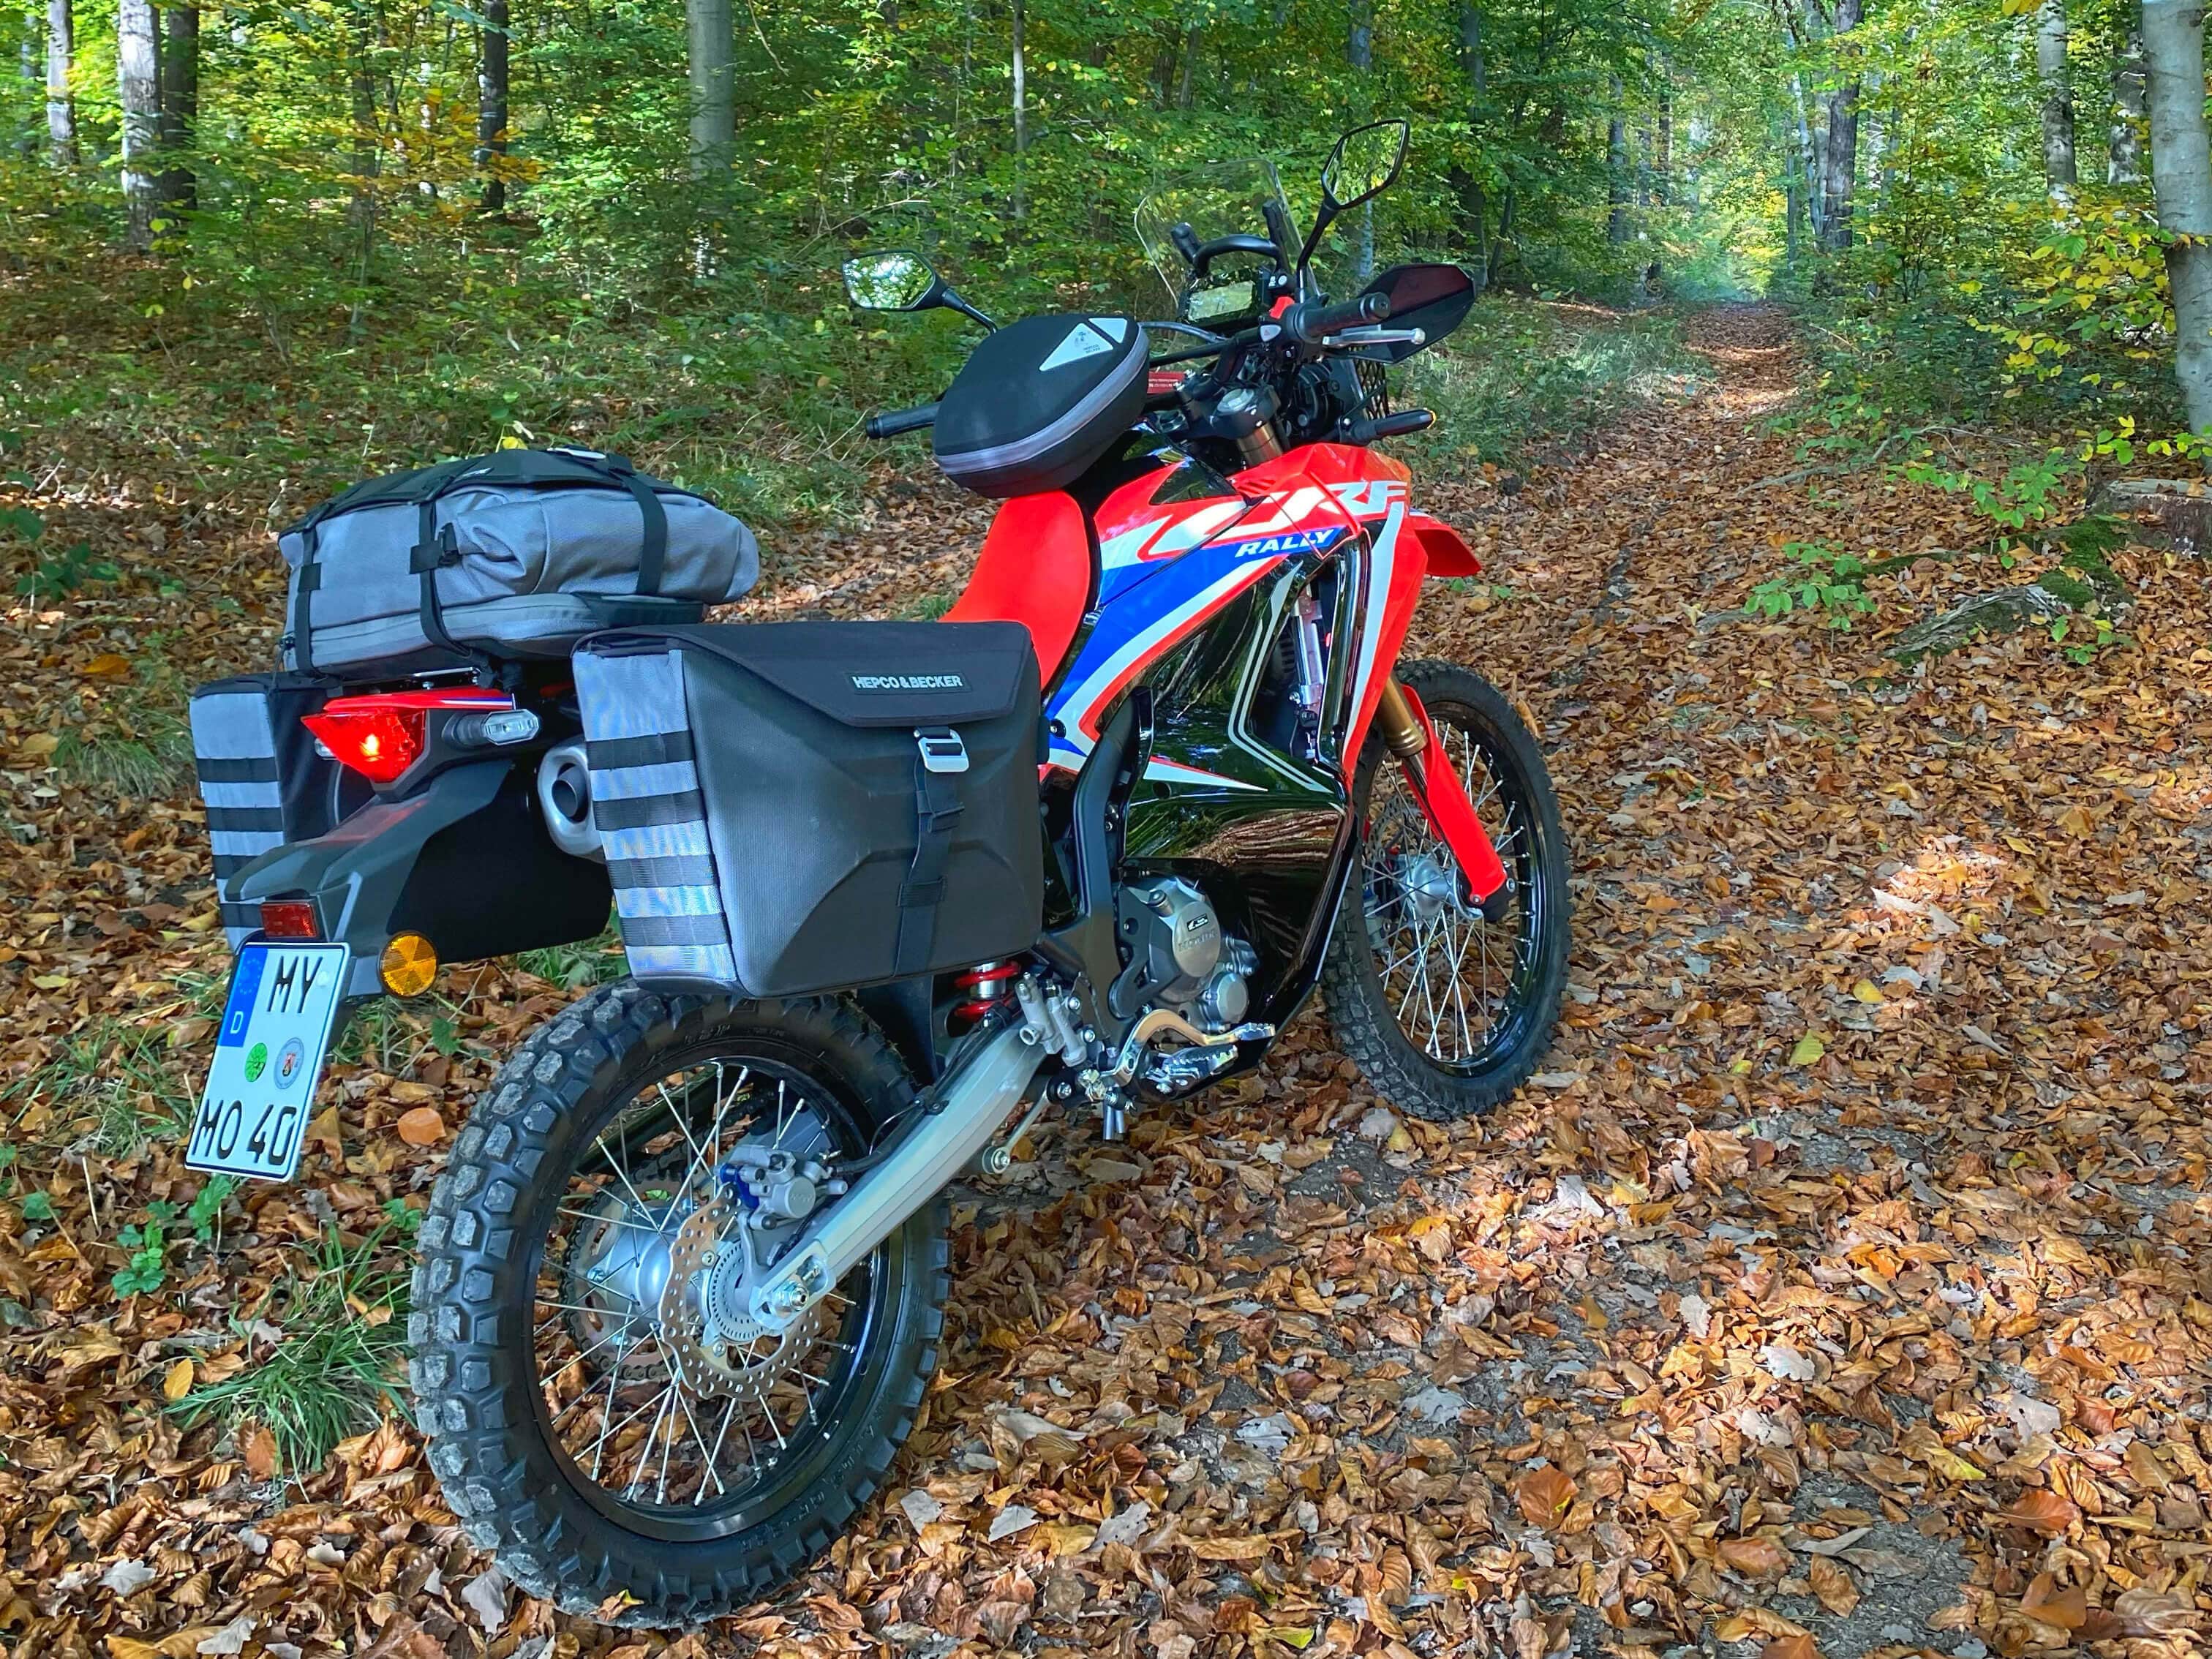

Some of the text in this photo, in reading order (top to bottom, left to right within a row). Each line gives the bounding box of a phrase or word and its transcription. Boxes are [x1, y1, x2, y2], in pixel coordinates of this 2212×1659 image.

[1147, 480, 1410, 556] CRF
[1235, 529, 1334, 558] RALLY
[266, 955, 323, 1014] MY
[230, 1011, 244, 1034] D
[191, 1098, 297, 1166] MO 40
